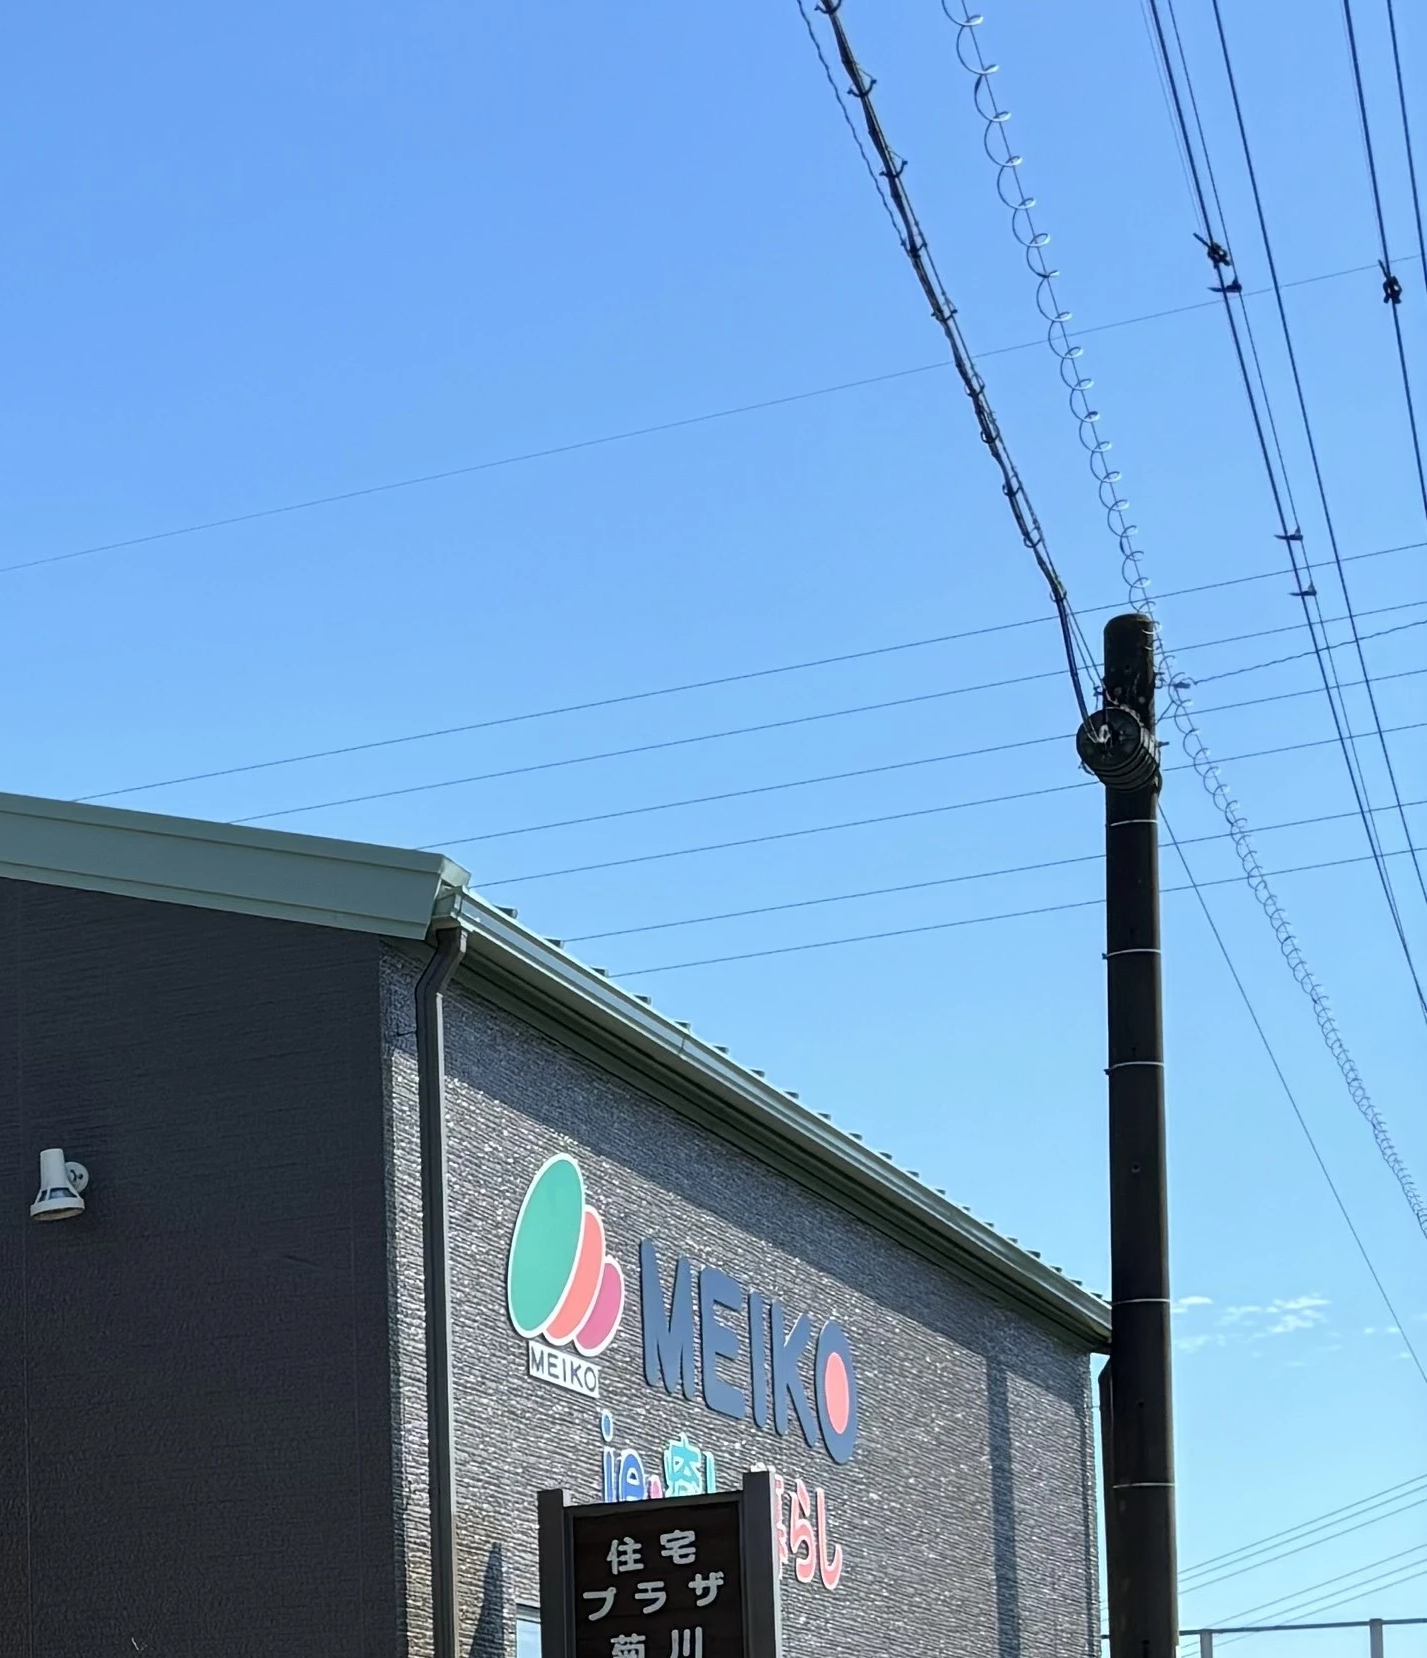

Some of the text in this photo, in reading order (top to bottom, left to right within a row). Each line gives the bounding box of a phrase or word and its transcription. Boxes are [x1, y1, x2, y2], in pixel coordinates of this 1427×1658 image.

[531, 1345, 597, 1393] MEIKO
[640, 1236, 859, 1465] MEIKO
[606, 1529, 697, 1575] 住宅
[582, 1570, 725, 1621] プラザ
